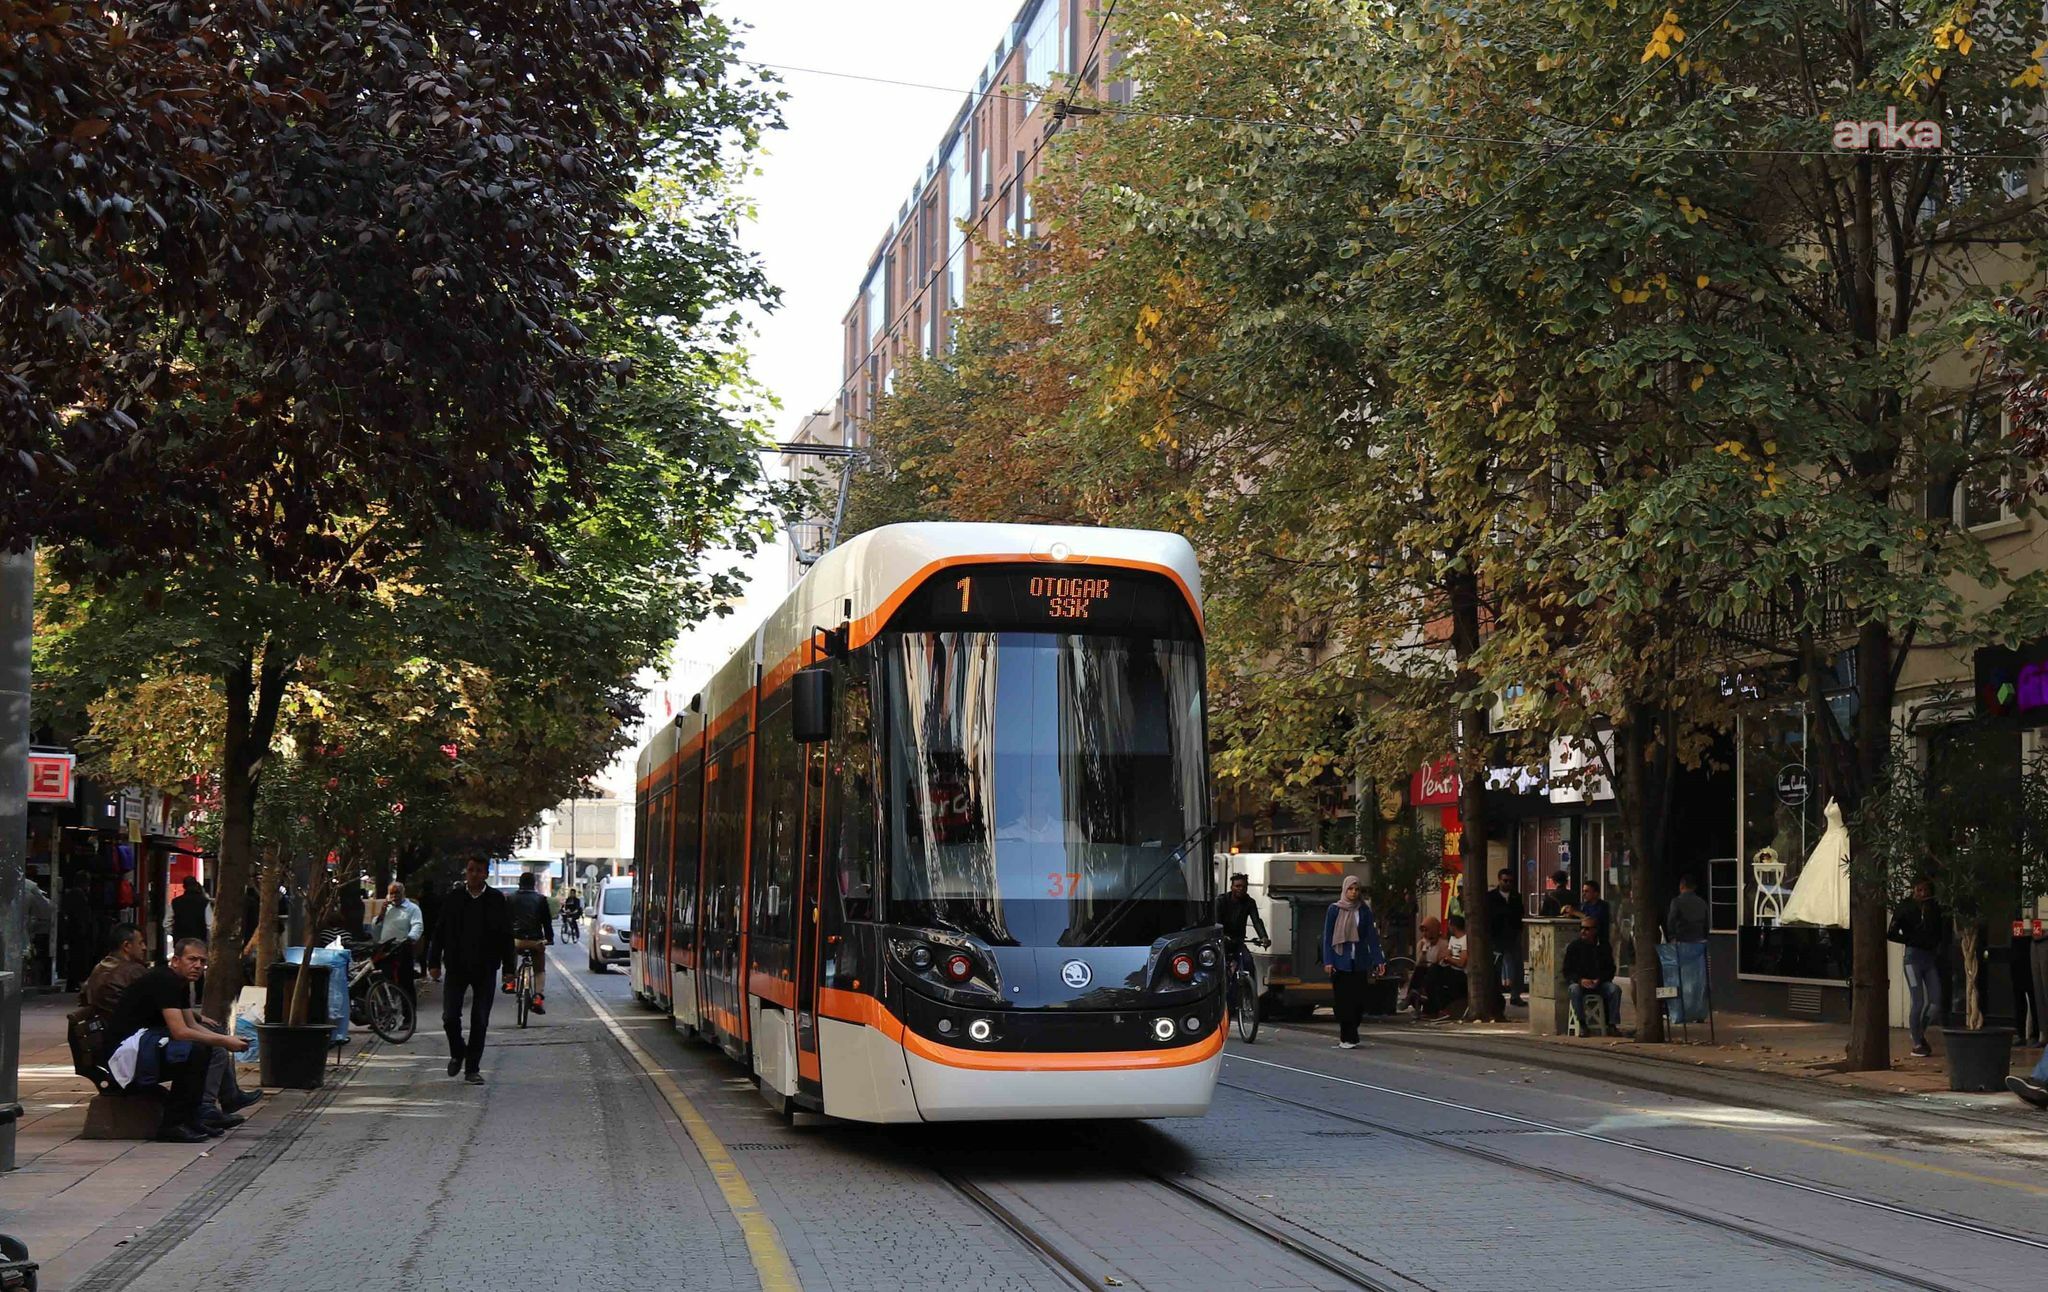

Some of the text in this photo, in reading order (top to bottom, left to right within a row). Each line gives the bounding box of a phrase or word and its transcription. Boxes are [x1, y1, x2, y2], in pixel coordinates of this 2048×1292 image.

[957, 576, 971, 612] 1
[1029, 576, 1110, 599] OTOGAR
[1049, 597, 1089, 618] SSK
[34, 764, 60, 792] E
[1047, 871, 1082, 897] 37
